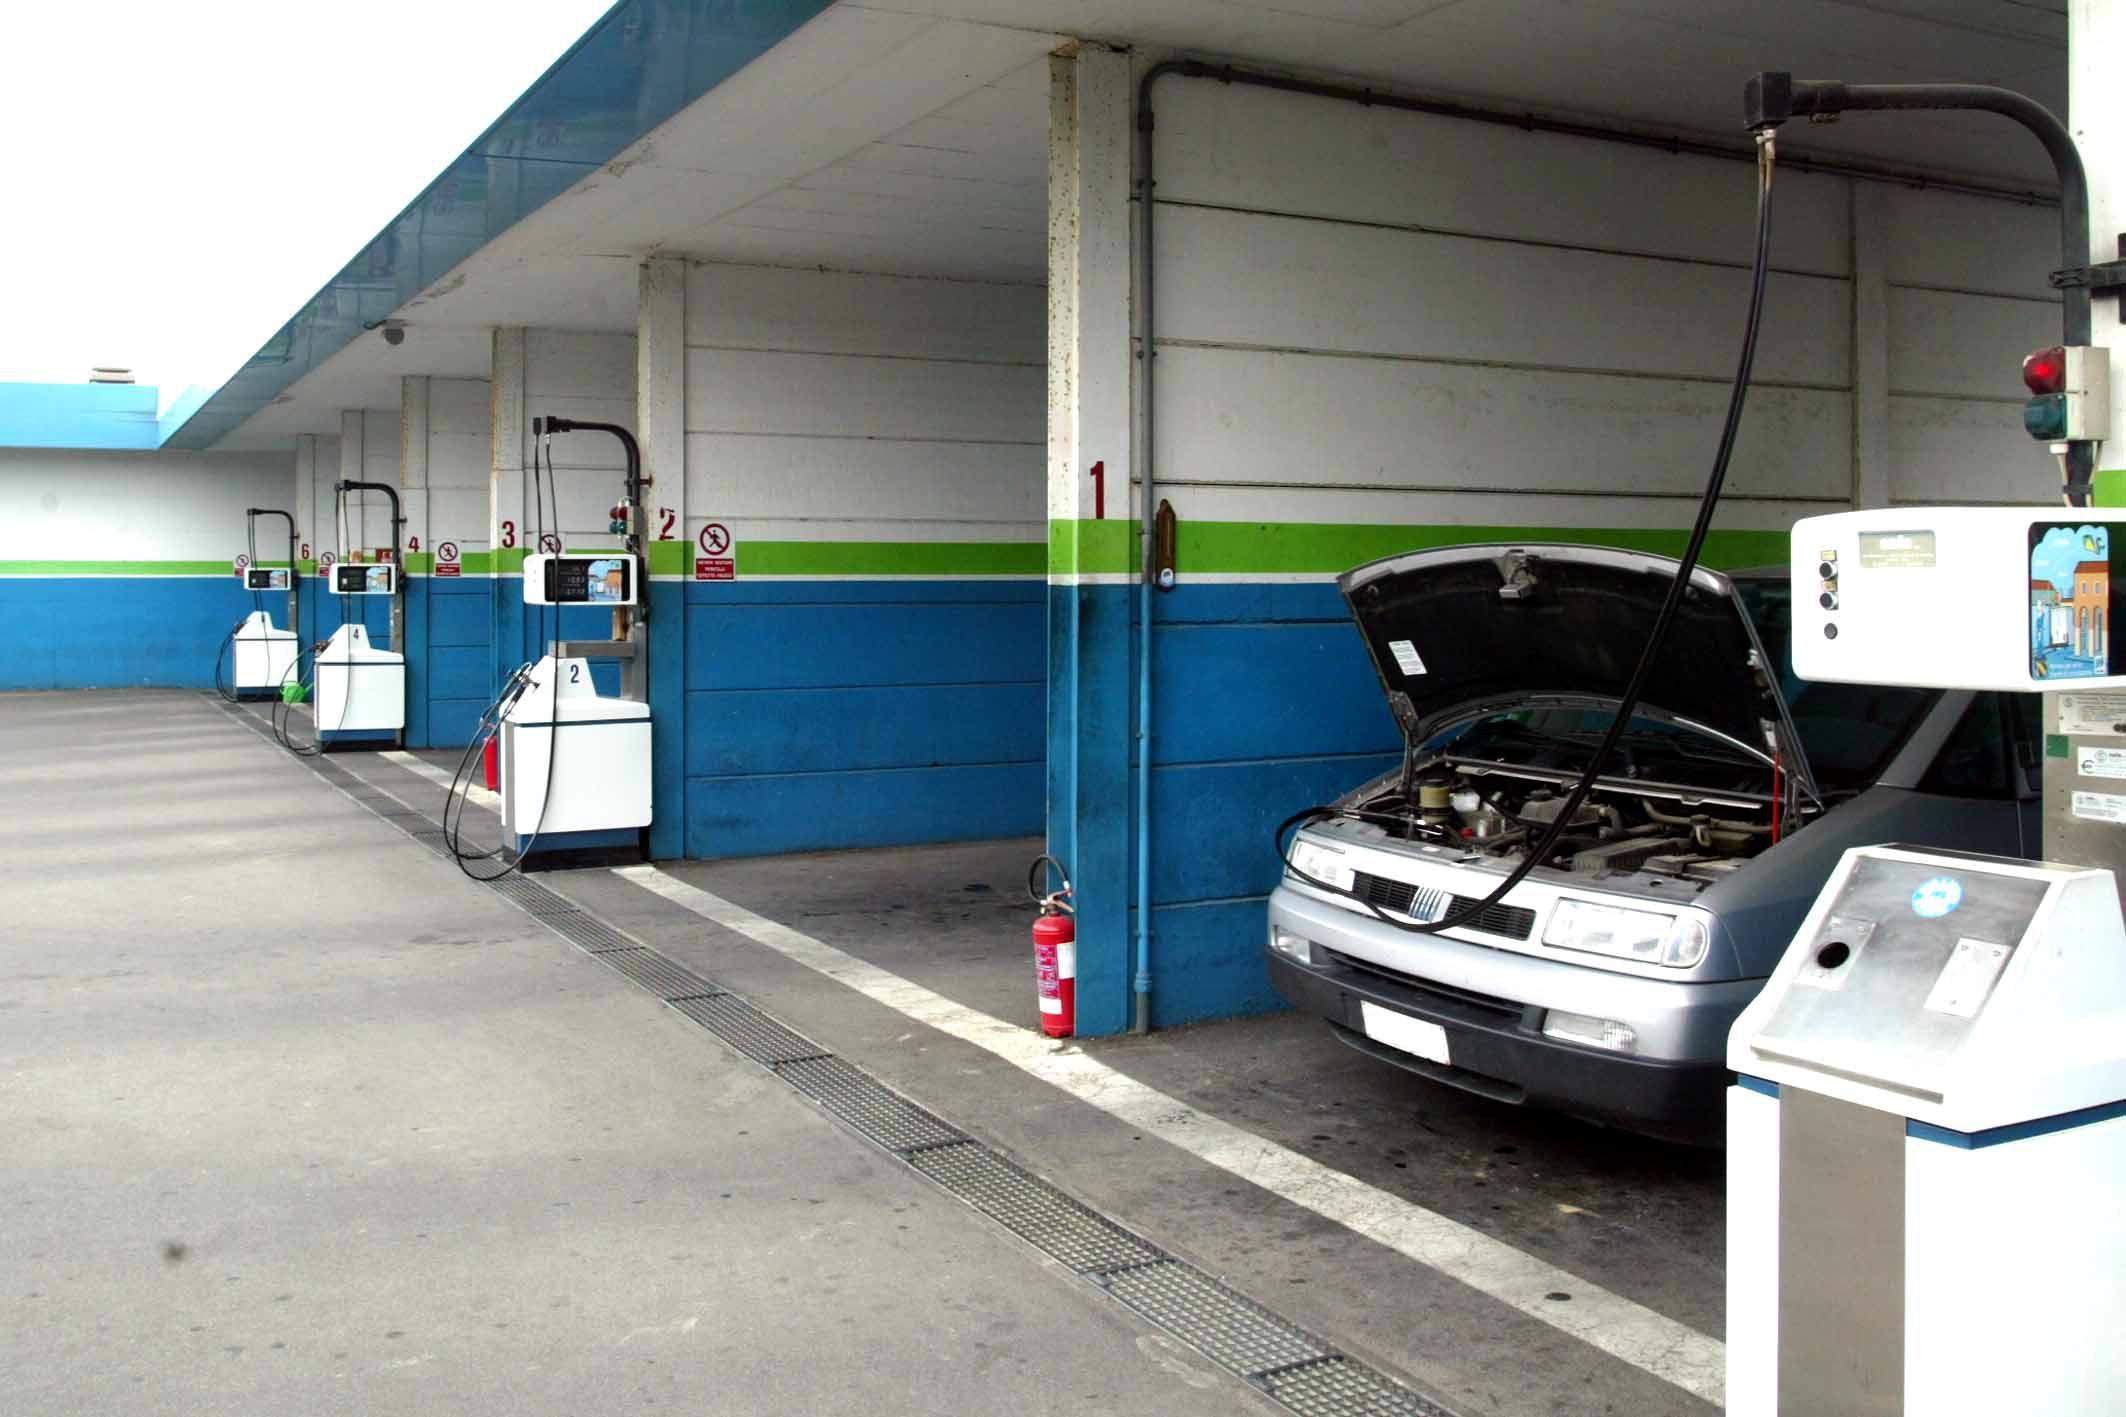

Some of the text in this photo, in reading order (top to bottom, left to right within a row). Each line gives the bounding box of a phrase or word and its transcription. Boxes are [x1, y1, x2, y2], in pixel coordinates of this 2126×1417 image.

[1090, 461, 1105, 519] 1
[502, 520, 516, 549] 3
[659, 507, 677, 541] 2
[301, 543, 310, 560] 6
[408, 536, 420, 553] 4
[570, 664, 580, 684] 2
